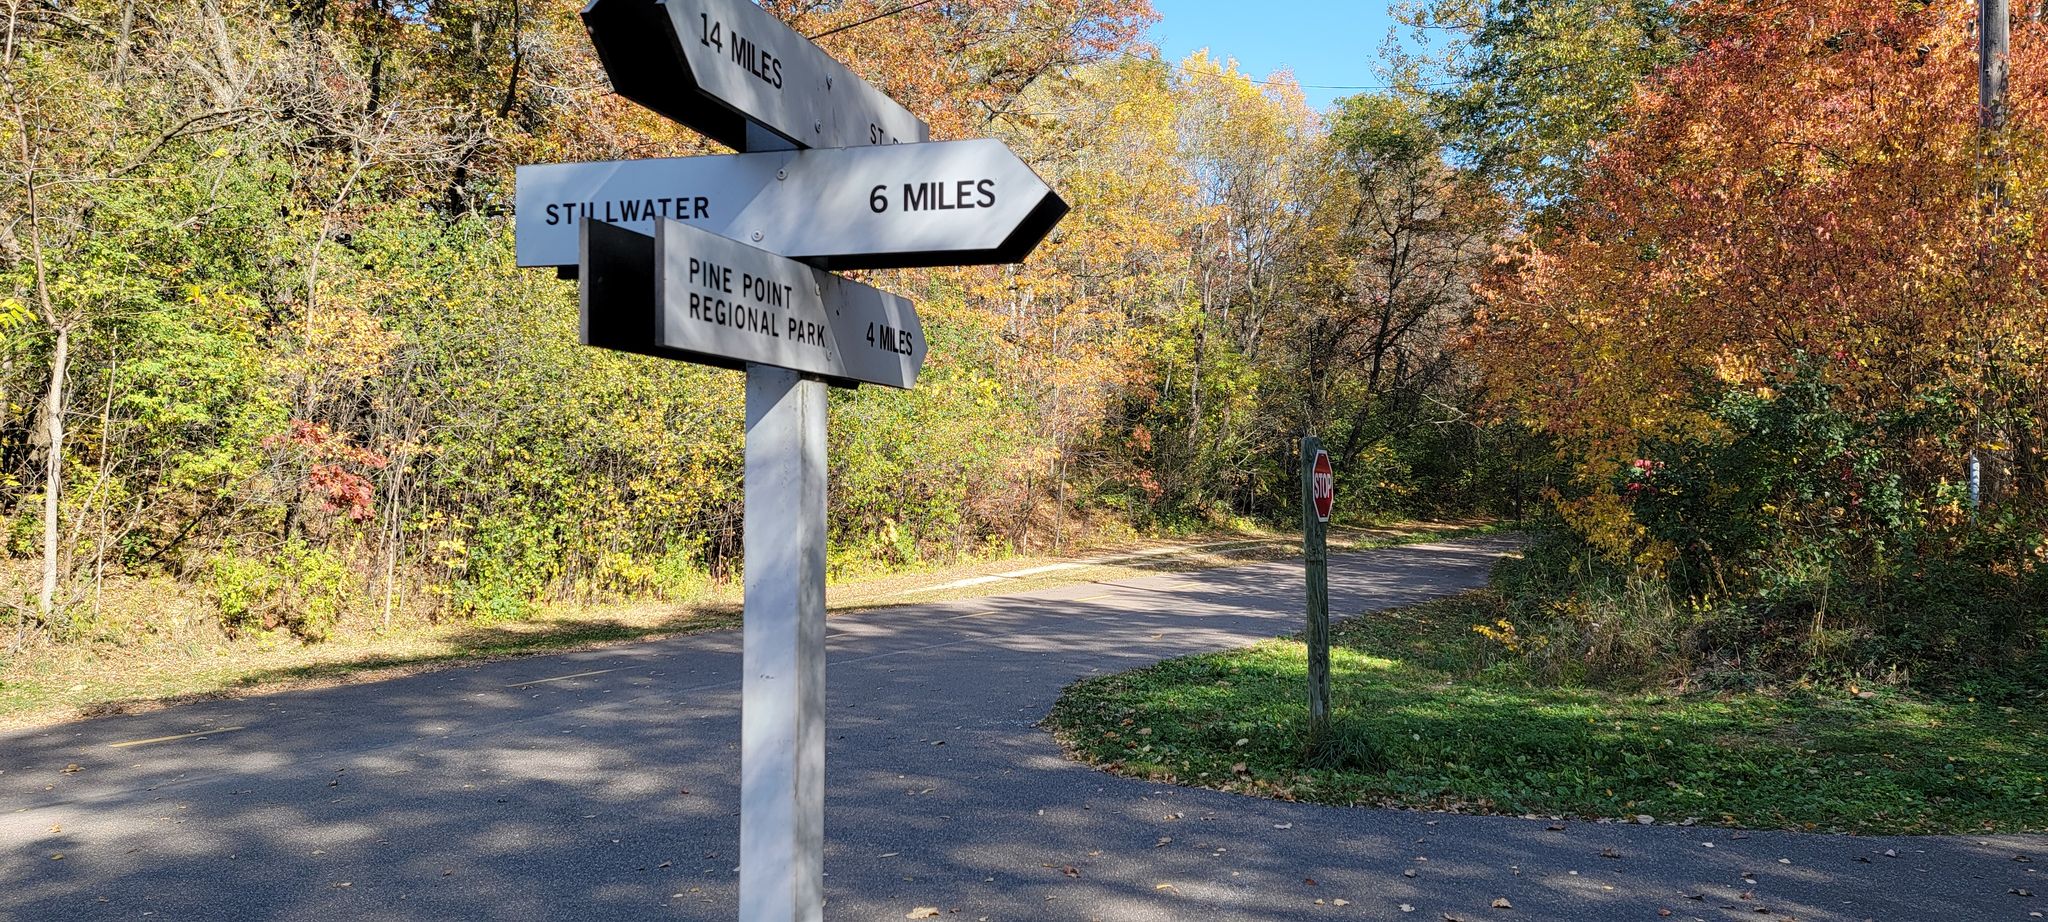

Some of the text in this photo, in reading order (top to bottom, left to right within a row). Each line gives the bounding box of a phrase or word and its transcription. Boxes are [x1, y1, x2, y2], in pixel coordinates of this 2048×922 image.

[701, 13, 782, 89] 14 MILES
[870, 123, 884, 145] ST
[869, 184, 888, 213] 6
[903, 179, 995, 212] MILES
[690, 257, 792, 309] PINE POINT
[690, 292, 826, 347] REGIONAL PARK
[866, 321, 913, 356] 4 MILES
[1314, 472, 1332, 499] STOP
